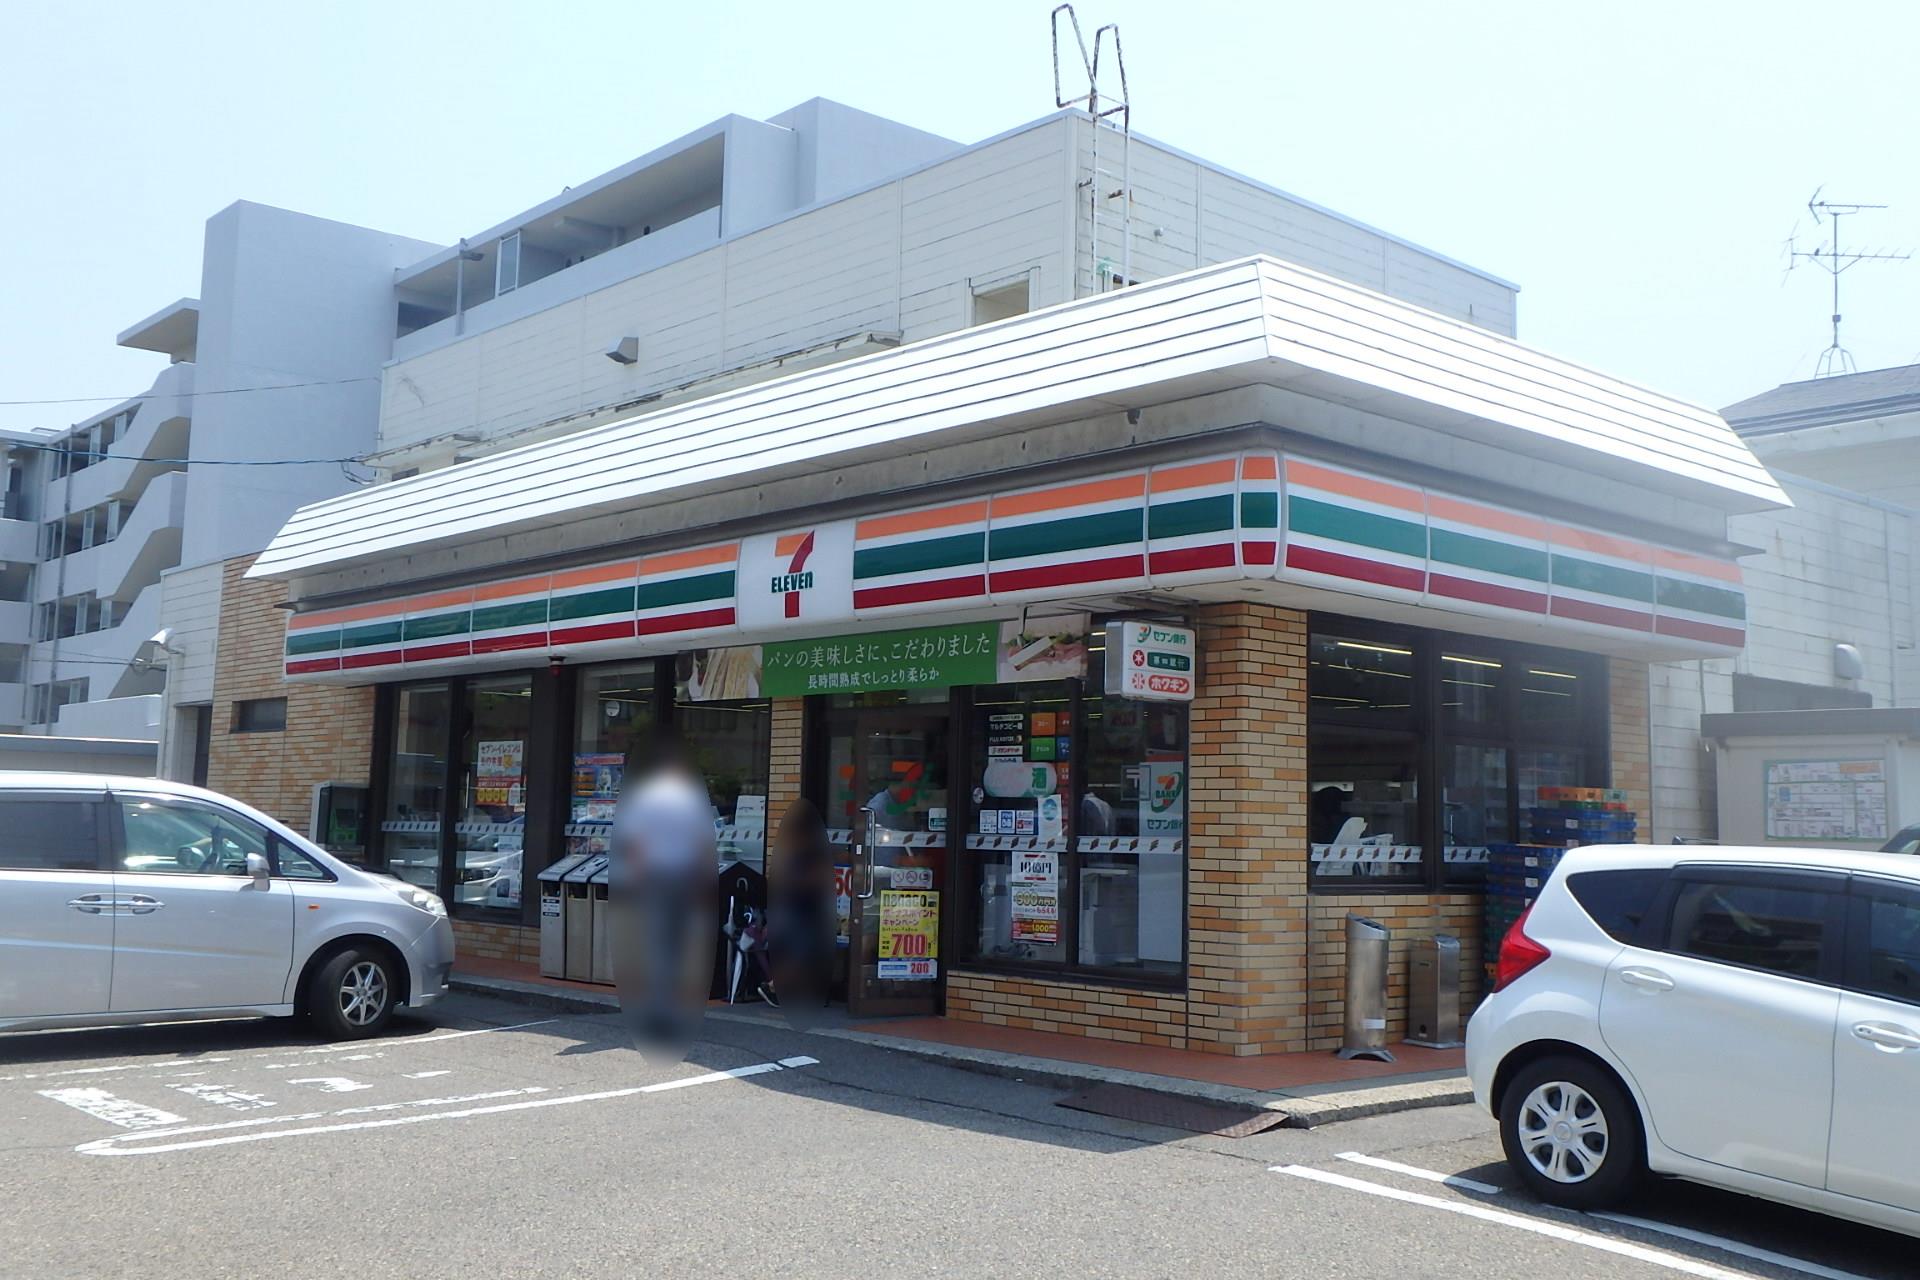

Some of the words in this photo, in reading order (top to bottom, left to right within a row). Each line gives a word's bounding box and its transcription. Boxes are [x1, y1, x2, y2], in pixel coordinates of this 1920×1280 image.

[775, 530, 815, 618] 7
[767, 632, 991, 669] パンの美味しさに、こだわりました
[808, 666, 940, 690] 長時間熟成でしっとり柔らか
[1151, 678, 1188, 693] ホクギン
[891, 933, 928, 957] 700
